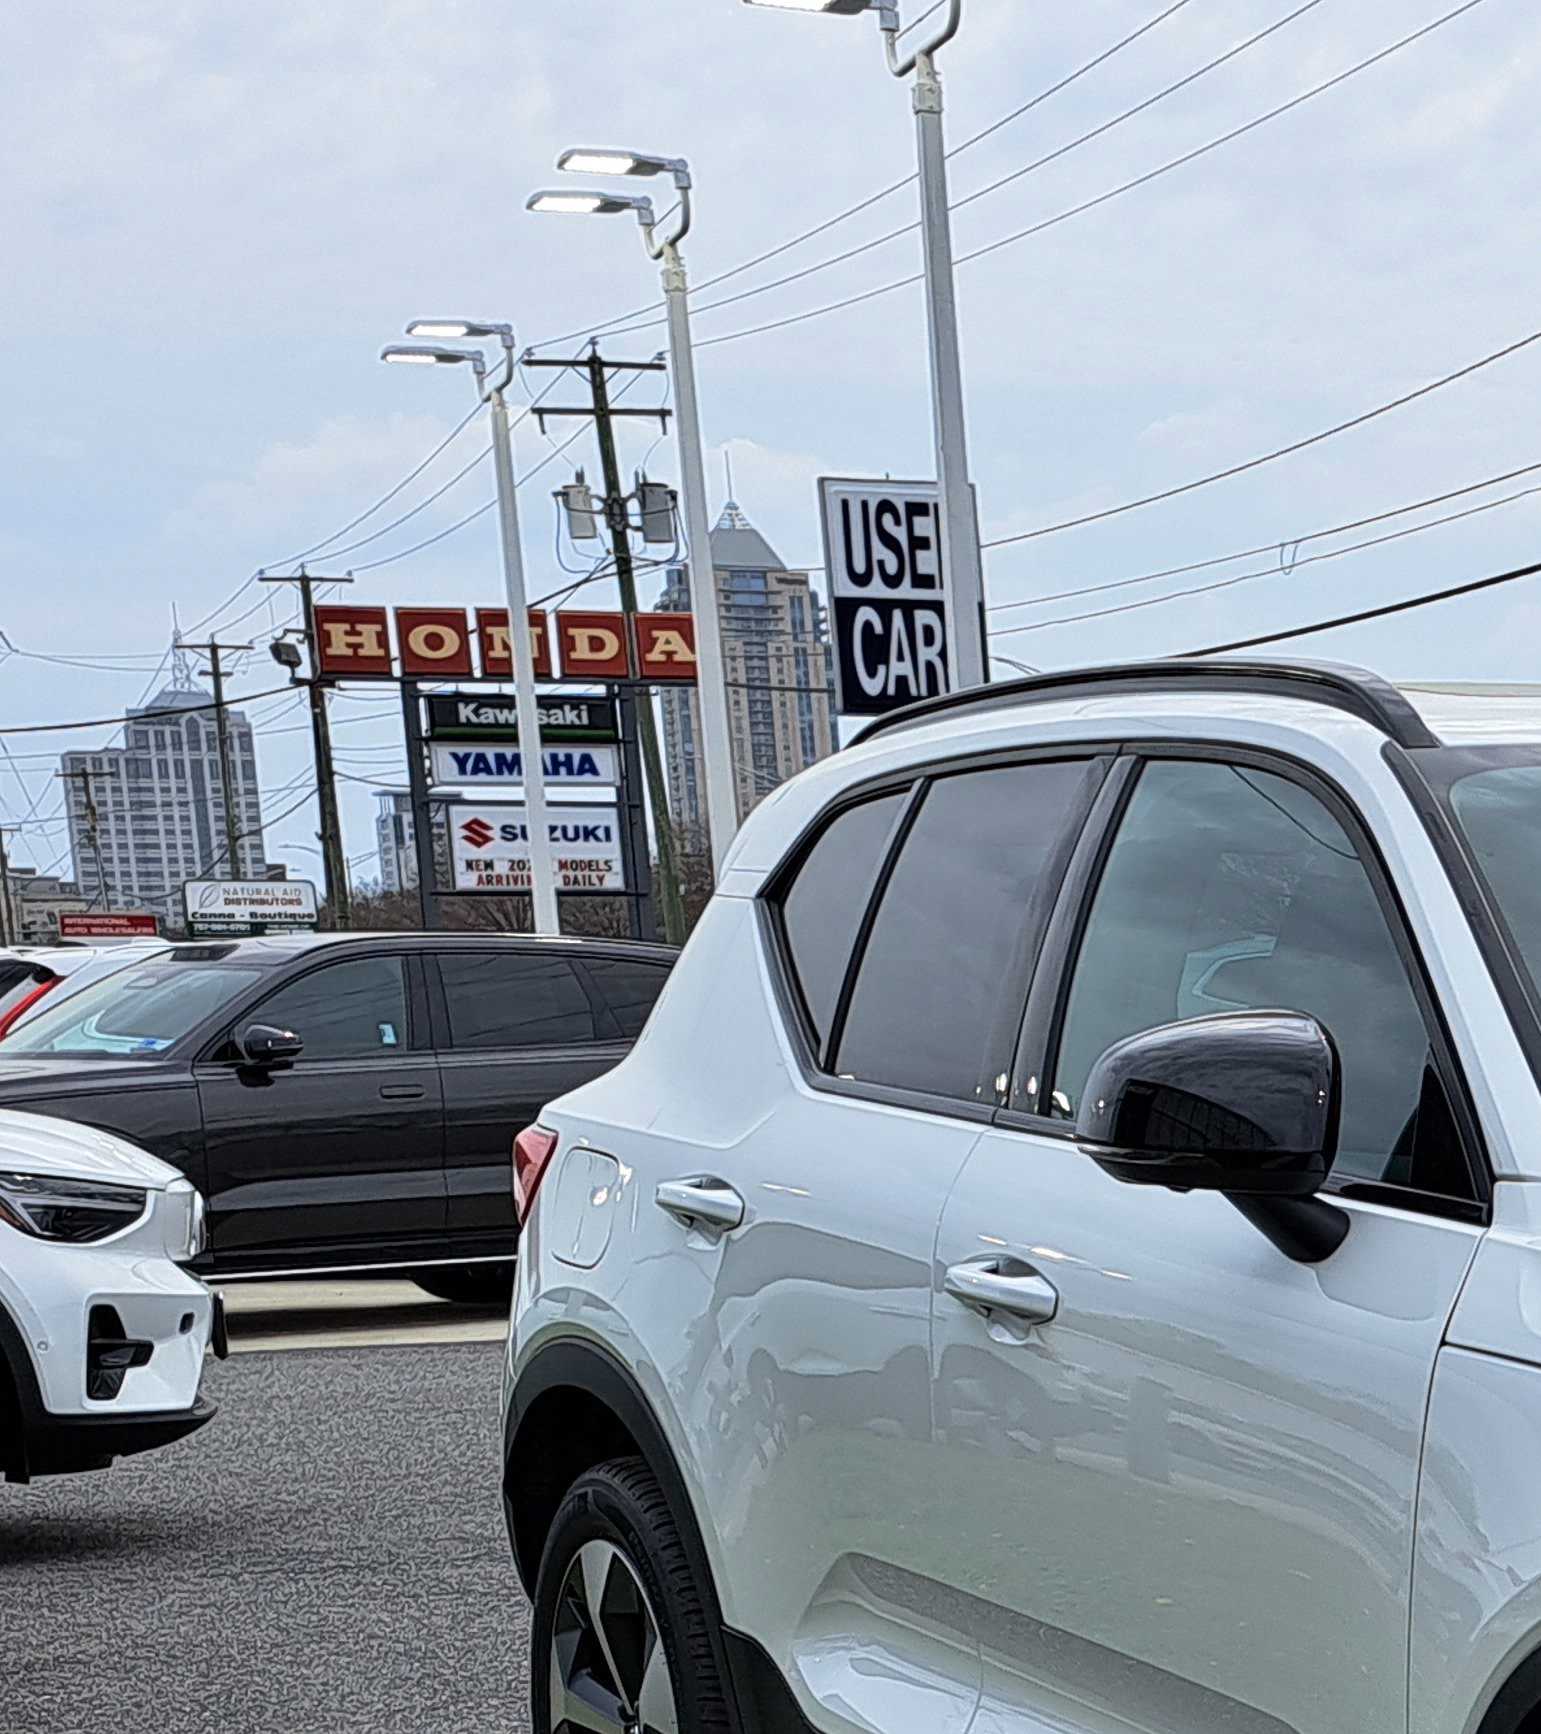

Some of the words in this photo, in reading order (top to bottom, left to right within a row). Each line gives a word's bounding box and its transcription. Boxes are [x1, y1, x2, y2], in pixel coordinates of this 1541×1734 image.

[841, 498, 943, 589] USE
[322, 622, 697, 662] HONDA
[853, 605, 946, 697] CAR
[457, 702, 590, 726] Kawsaki
[465, 858, 495, 873] NEW
[558, 859, 613, 873] MODELS
[563, 873, 606, 887] DAILY
[222, 887, 276, 897] NATURAL
[282, 887, 302, 897] AID
[249, 910, 315, 921] Boutique
